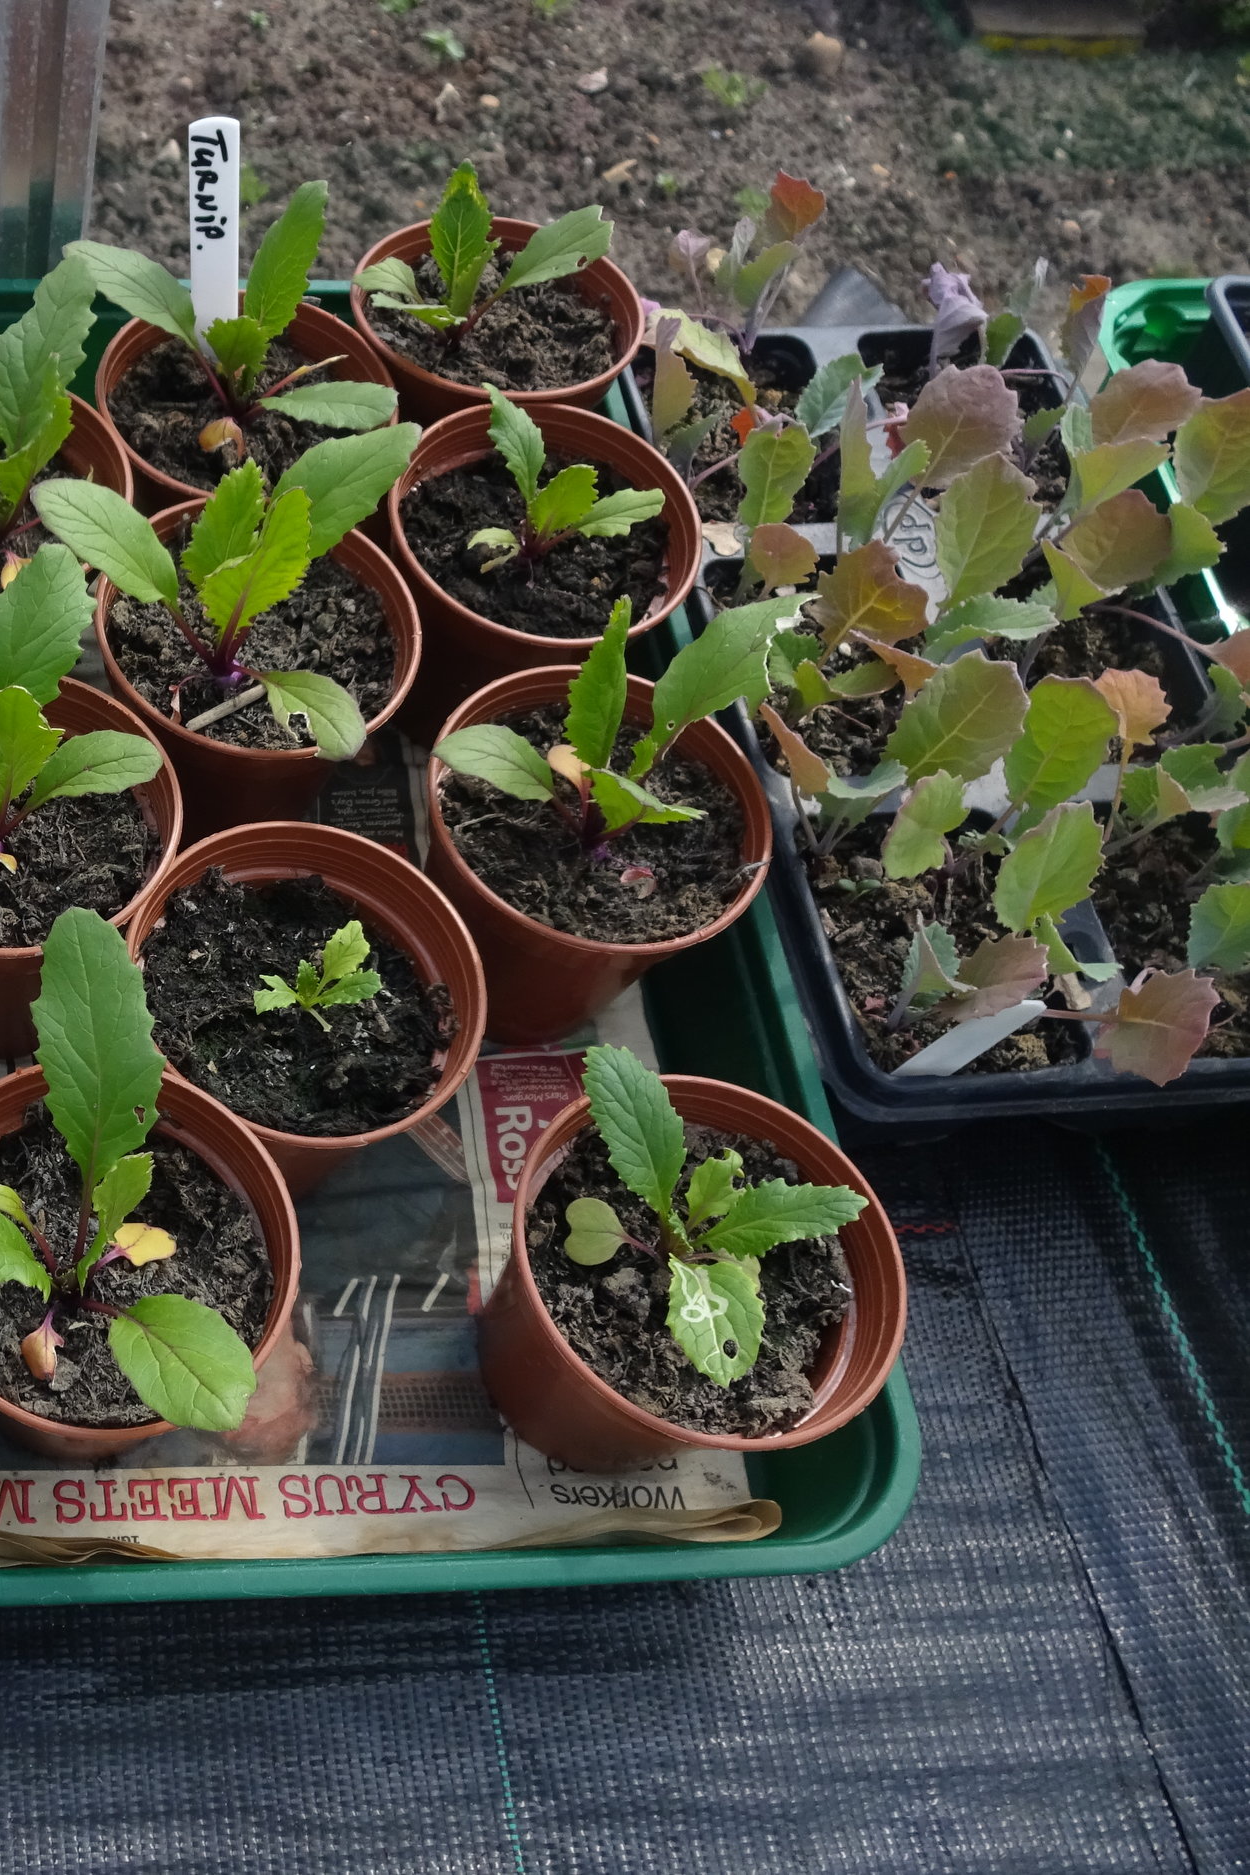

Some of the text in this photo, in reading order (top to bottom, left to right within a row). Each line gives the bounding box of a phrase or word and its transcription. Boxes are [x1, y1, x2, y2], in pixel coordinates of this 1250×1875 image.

[52, 1476, 267, 1524] MEETS
[278, 1474, 476, 1519] CYRUS
[550, 1484, 687, 1510] Workers
